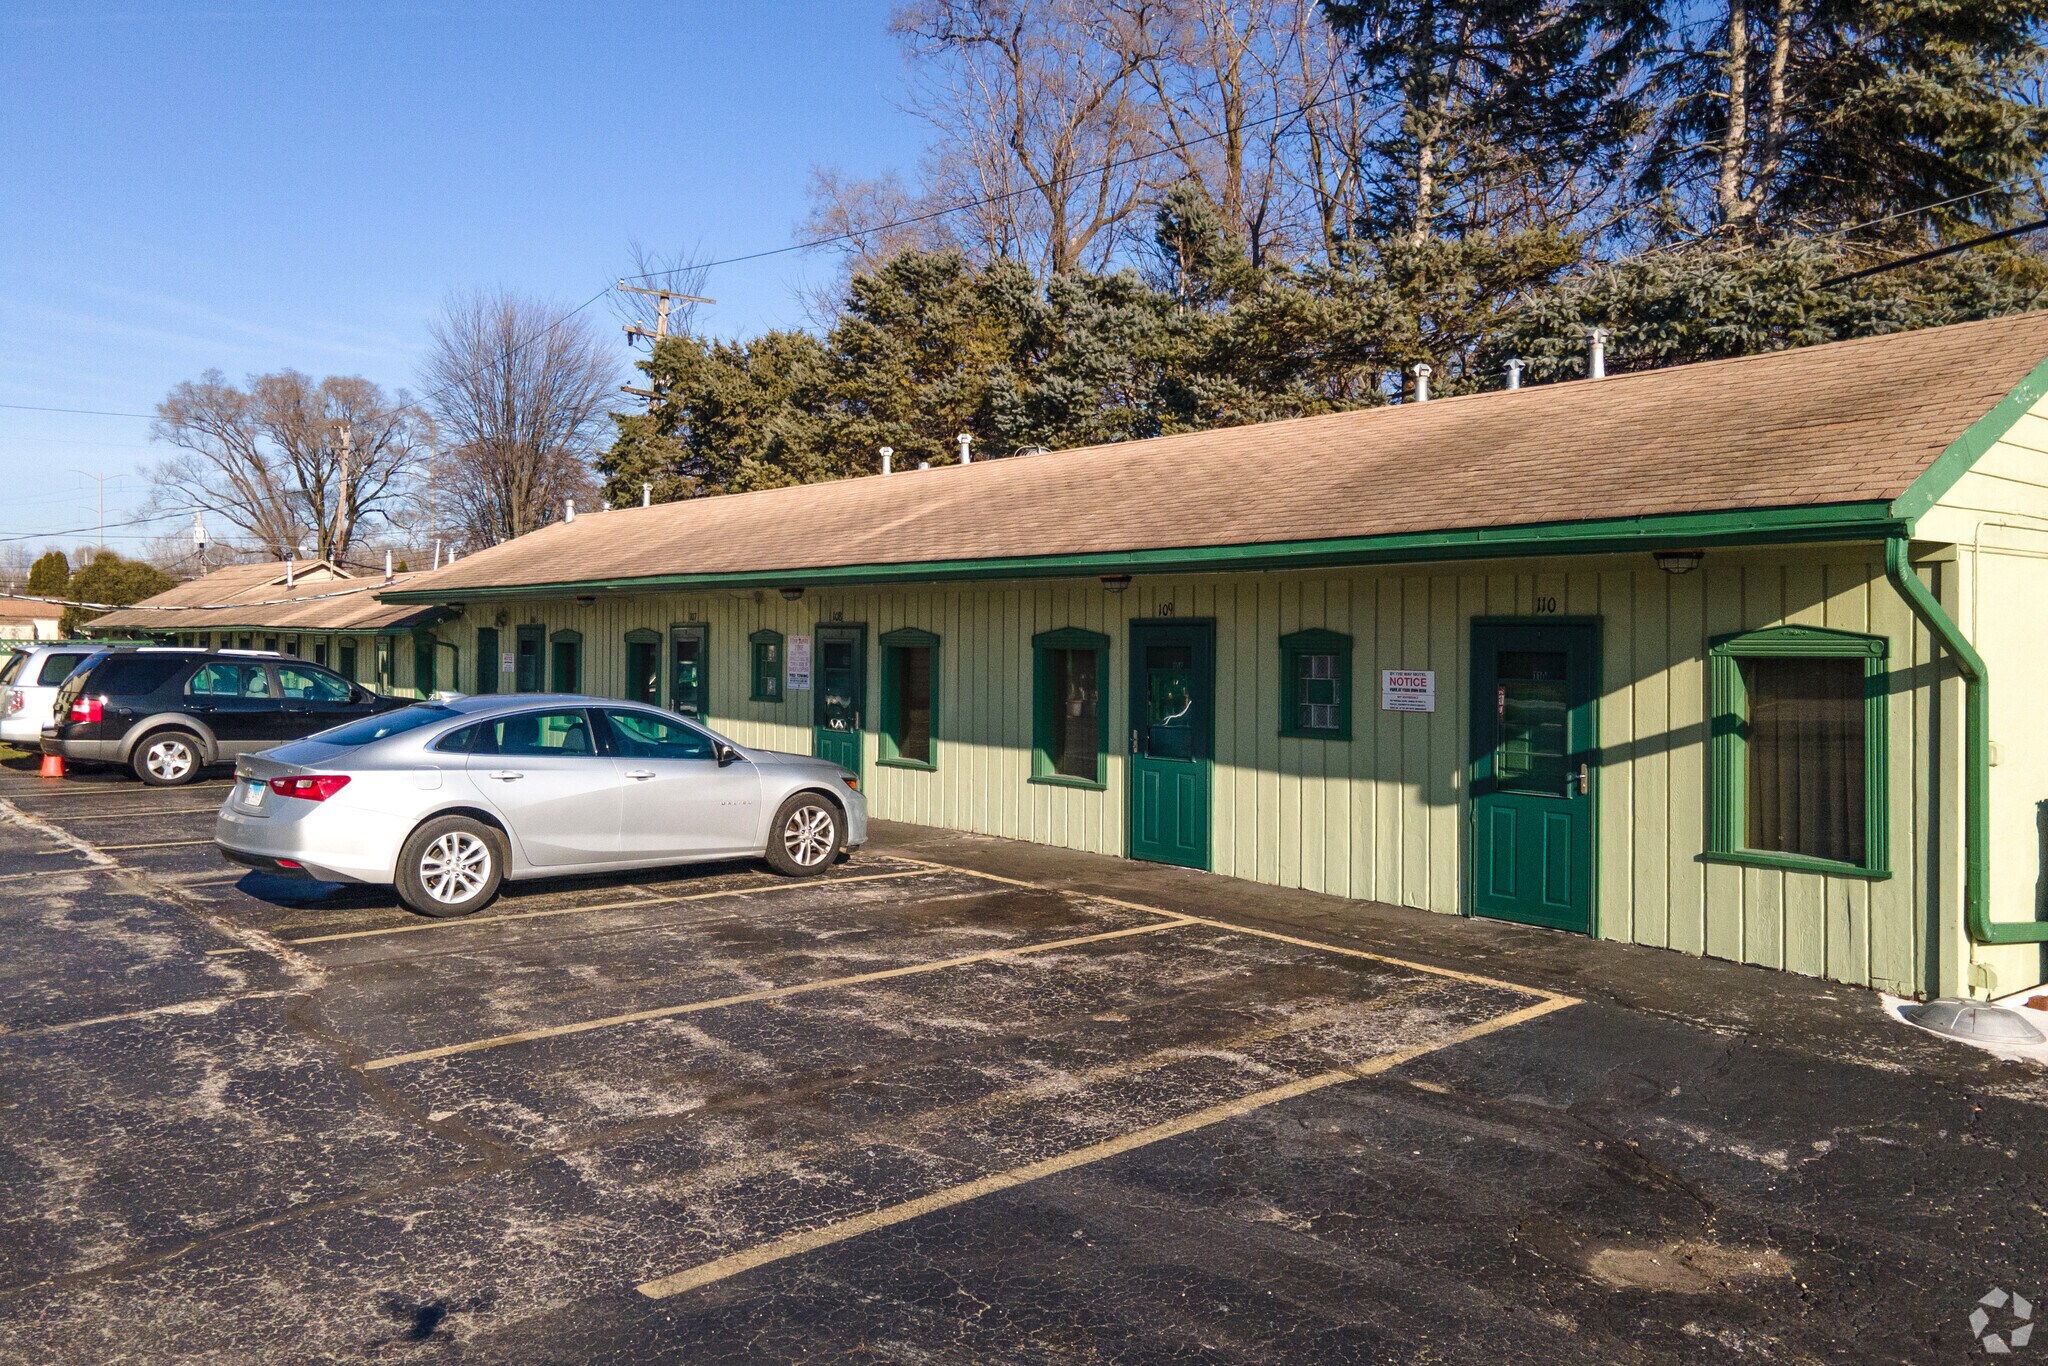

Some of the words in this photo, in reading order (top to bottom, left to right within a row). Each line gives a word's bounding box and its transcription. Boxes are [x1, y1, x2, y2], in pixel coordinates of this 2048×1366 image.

[1158, 602, 1173, 616] 109
[1537, 597, 1556, 613] 110
[833, 611, 843, 621] 108
[1390, 677, 1427, 687] NOTICE
